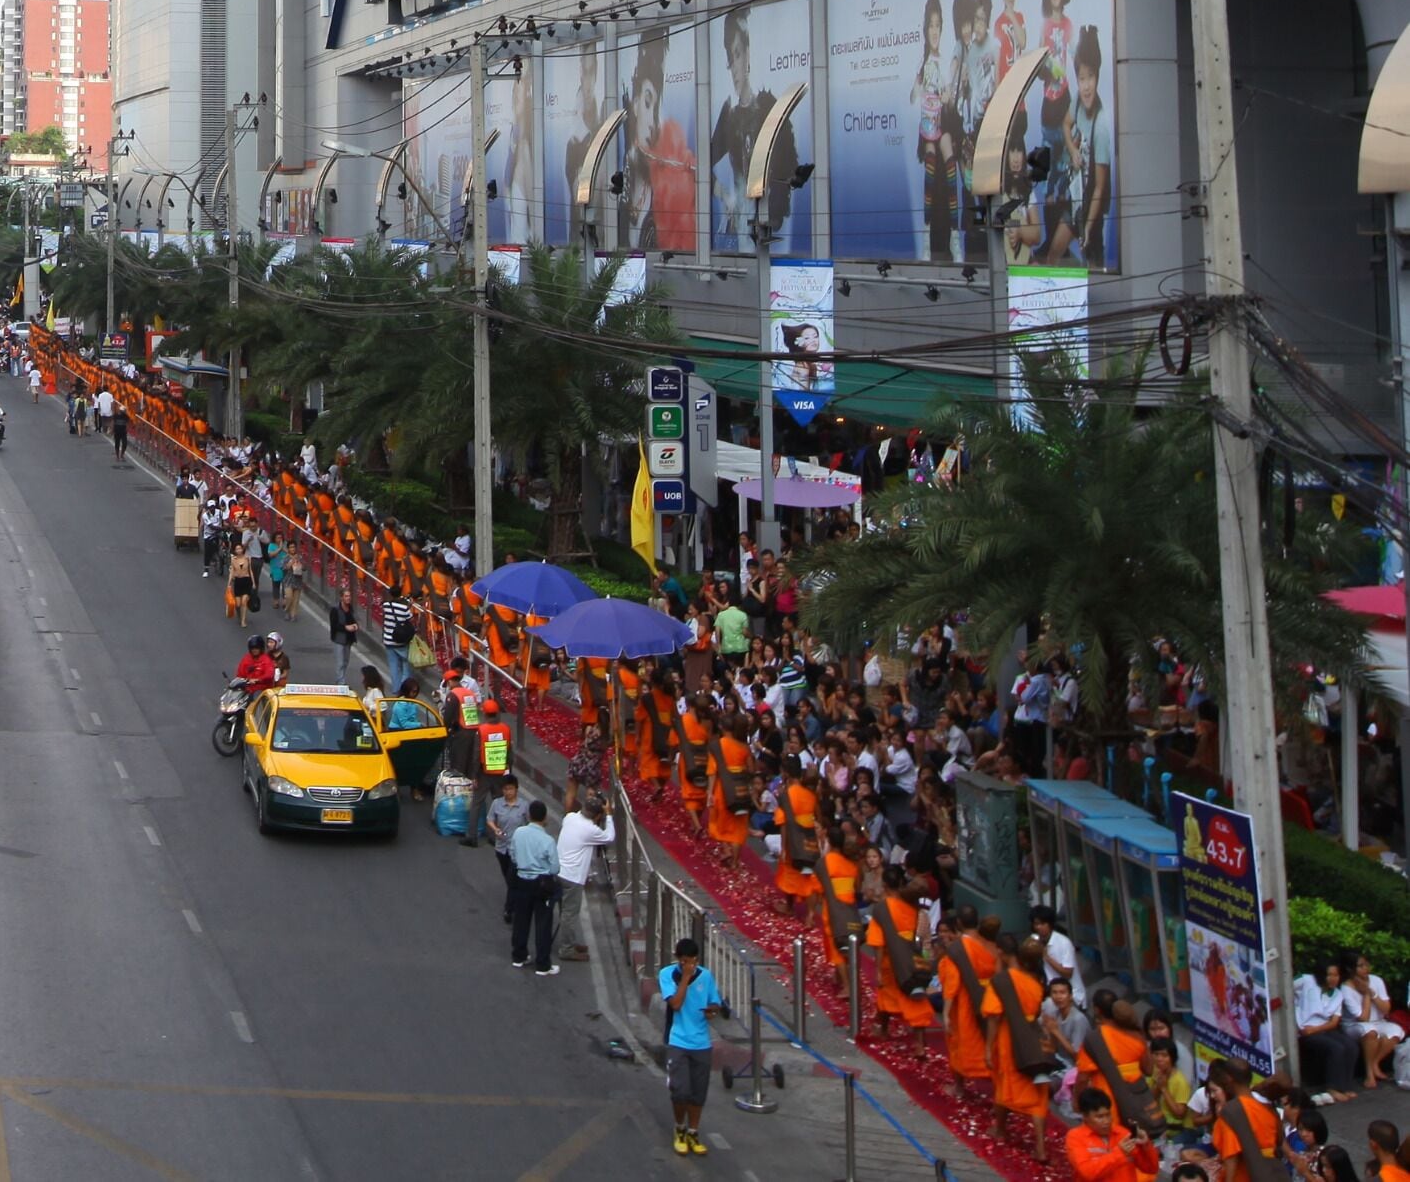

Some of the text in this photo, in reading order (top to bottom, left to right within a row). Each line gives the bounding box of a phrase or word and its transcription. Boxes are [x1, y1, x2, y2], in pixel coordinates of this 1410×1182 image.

[769, 50, 811, 72] Leather
[881, 55, 899, 66] 8000
[545, 93, 559, 107] Men
[843, 113, 897, 133] Children
[884, 135, 905, 147] Wear
[793, 401, 815, 409] VISA
[697, 424, 709, 451] 1
[664, 492, 682, 500] UOB
[1206, 839, 1246, 868] 43.7
